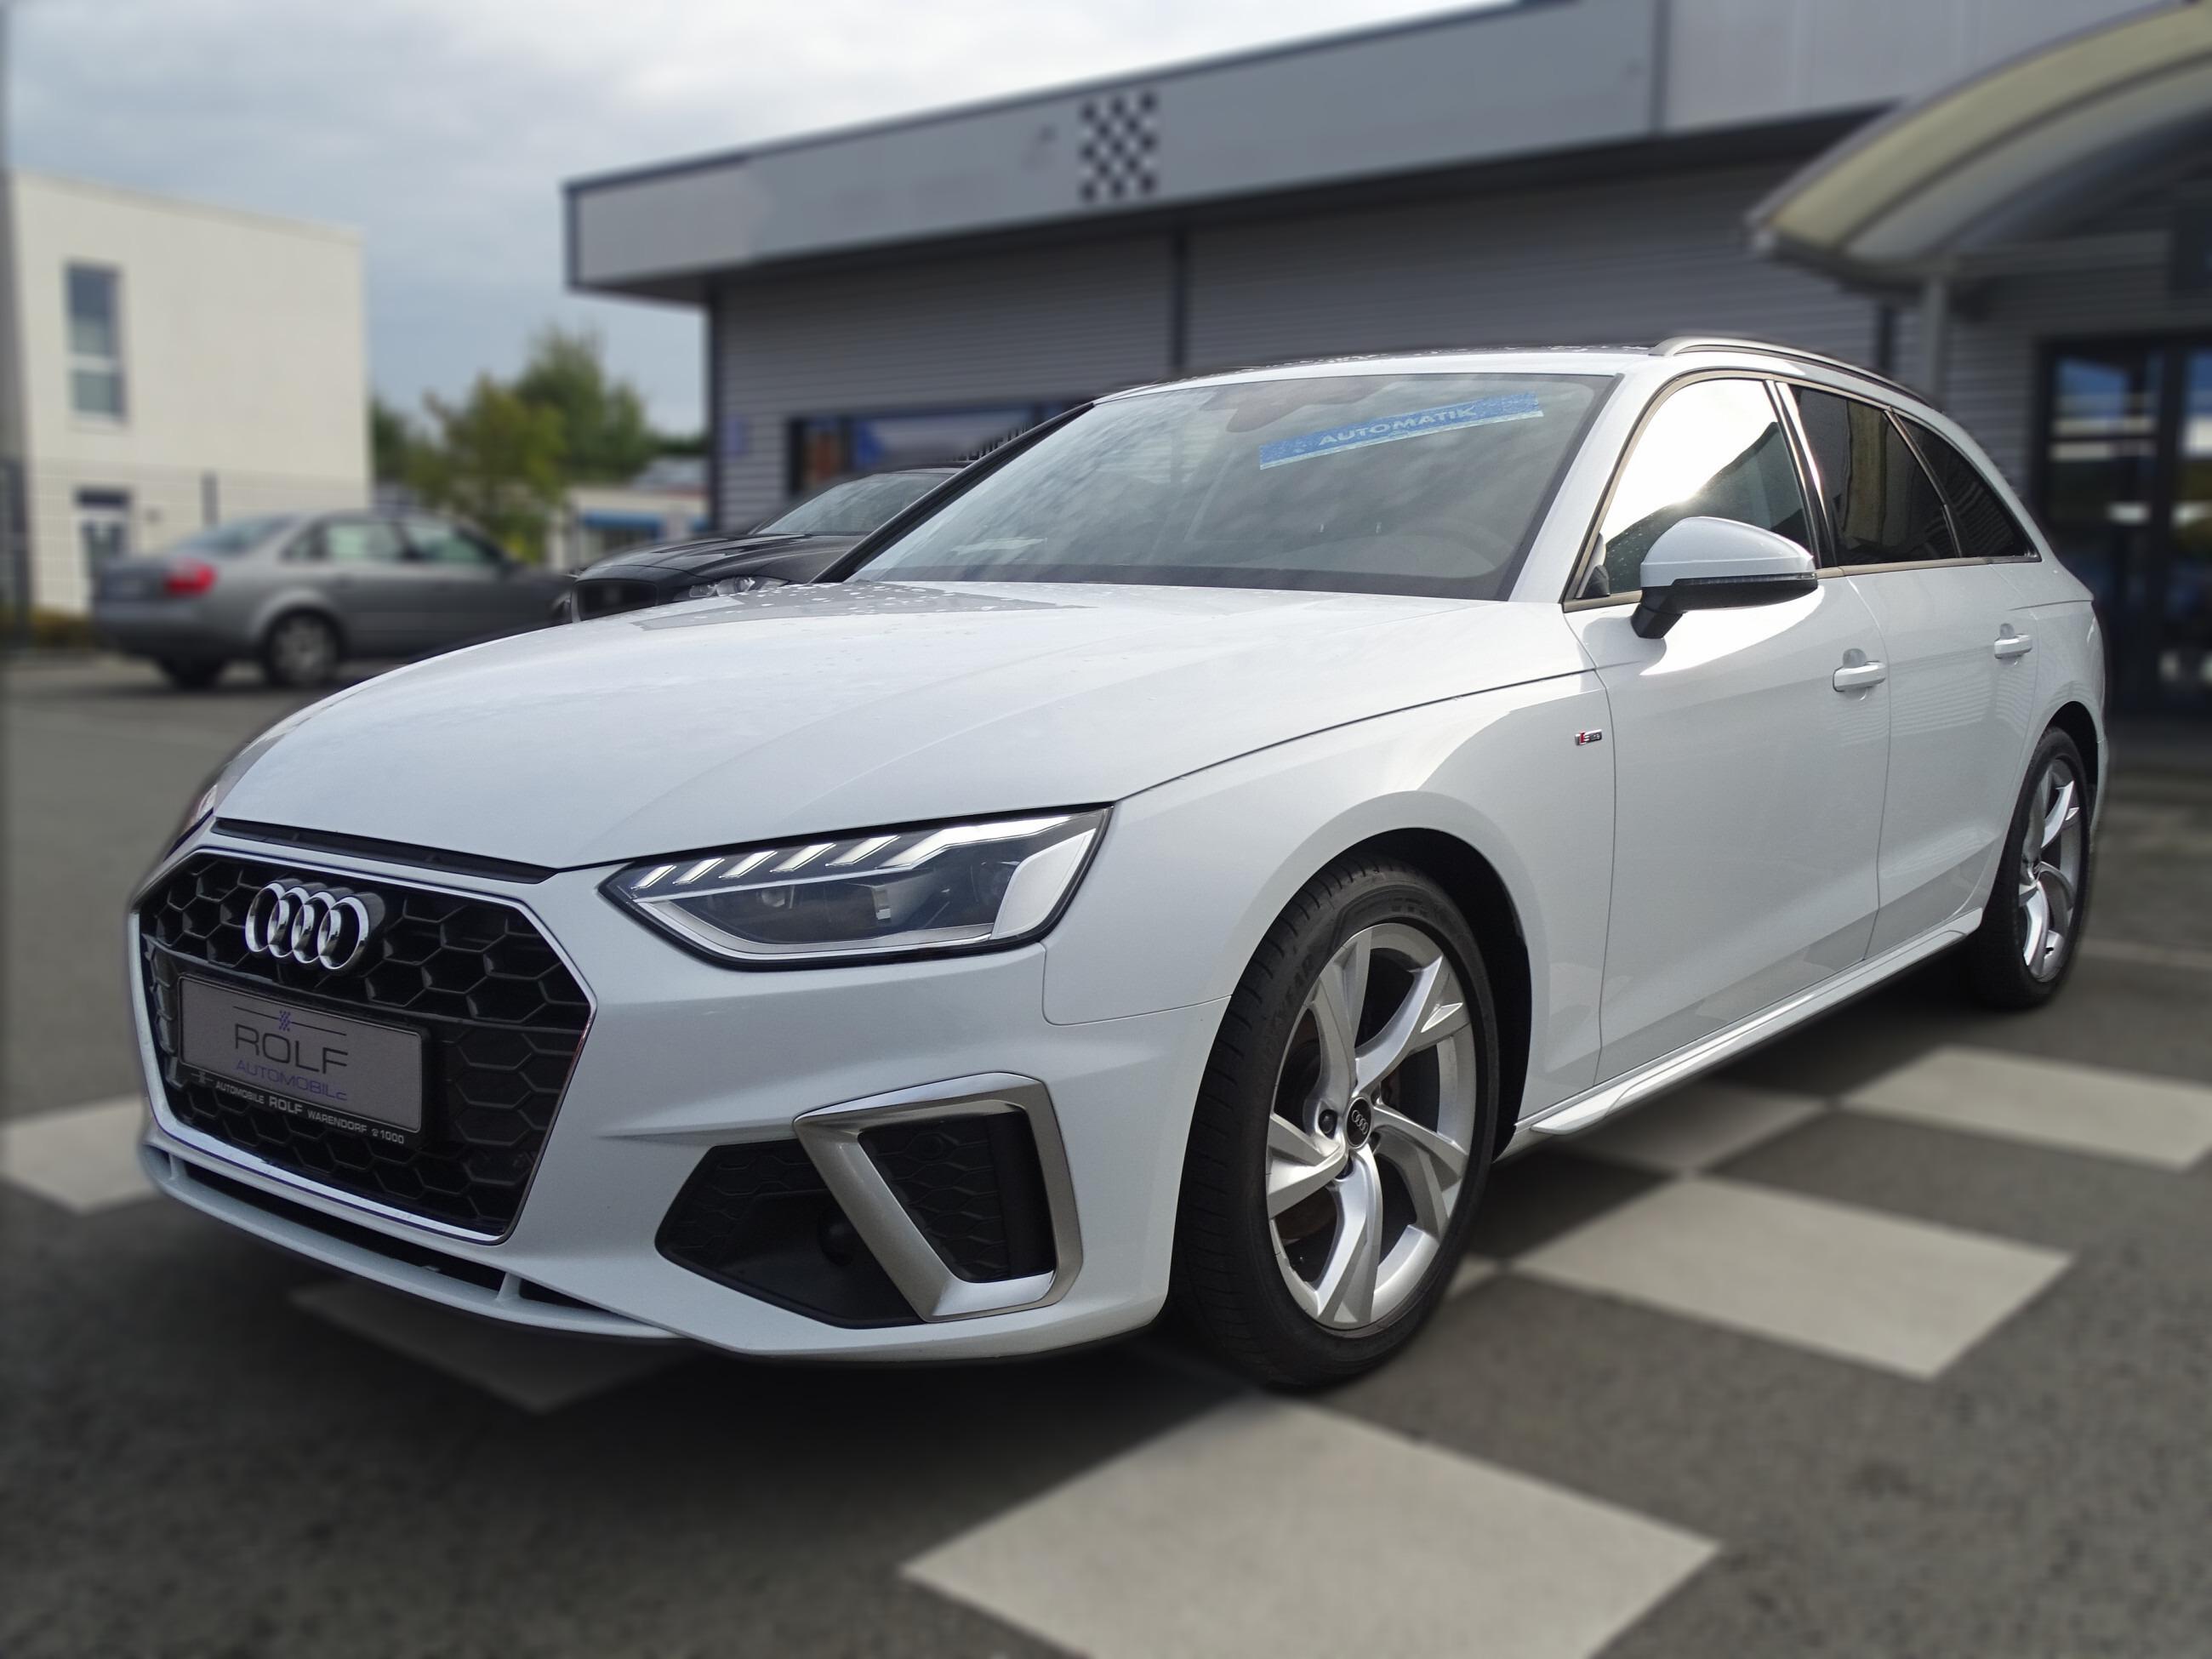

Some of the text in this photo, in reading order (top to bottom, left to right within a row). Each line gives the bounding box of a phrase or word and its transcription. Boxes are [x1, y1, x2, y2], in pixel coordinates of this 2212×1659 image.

[1319, 406, 1476, 446] AUTOMATIK
[235, 1024, 348, 1074] ROLF
[237, 1060, 347, 1101] AUTOMOBILE
[215, 1080, 265, 1104] AUTOMOBILE
[269, 1095, 303, 1115] ROLF
[307, 1109, 368, 1135] WARENDORF
